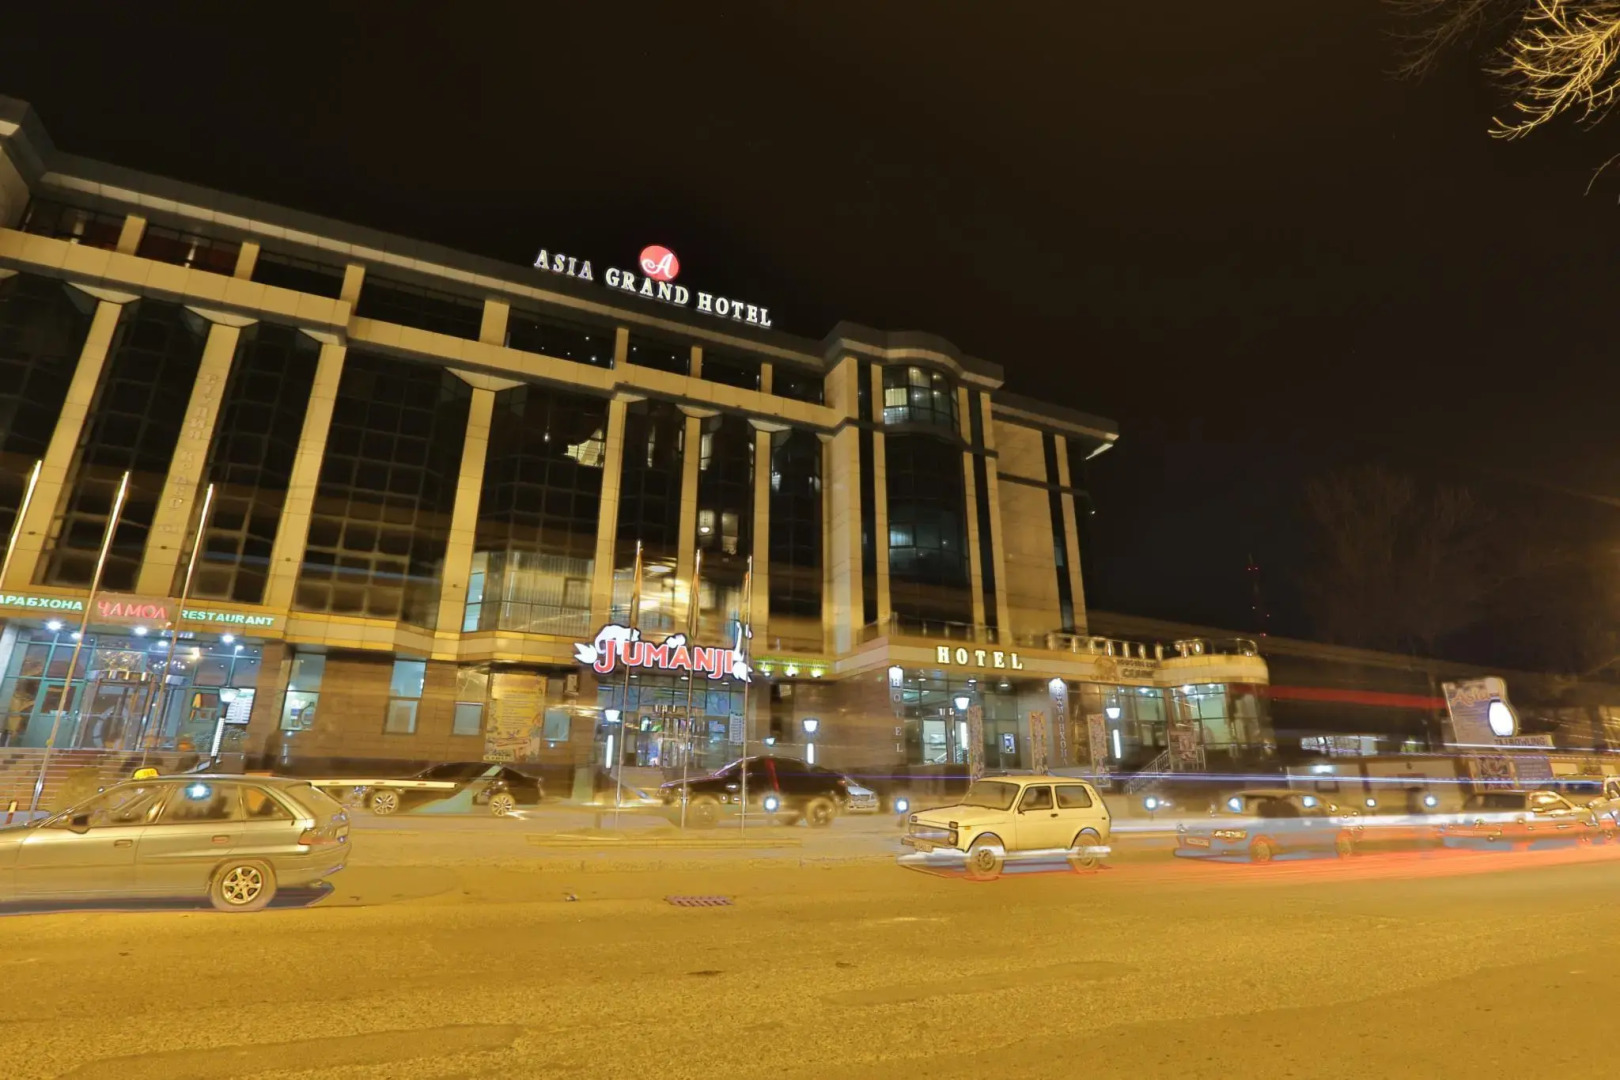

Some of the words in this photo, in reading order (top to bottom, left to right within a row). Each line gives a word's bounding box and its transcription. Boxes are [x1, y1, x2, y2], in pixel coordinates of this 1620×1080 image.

[533, 249, 594, 281] ASIA
[605, 267, 689, 304] GRAND
[697, 291, 772, 327] HOTEL
[182, 609, 275, 627] RESTAURANT
[593, 639, 734, 680] JUMANJI
[937, 645, 1023, 671] HOTEL
